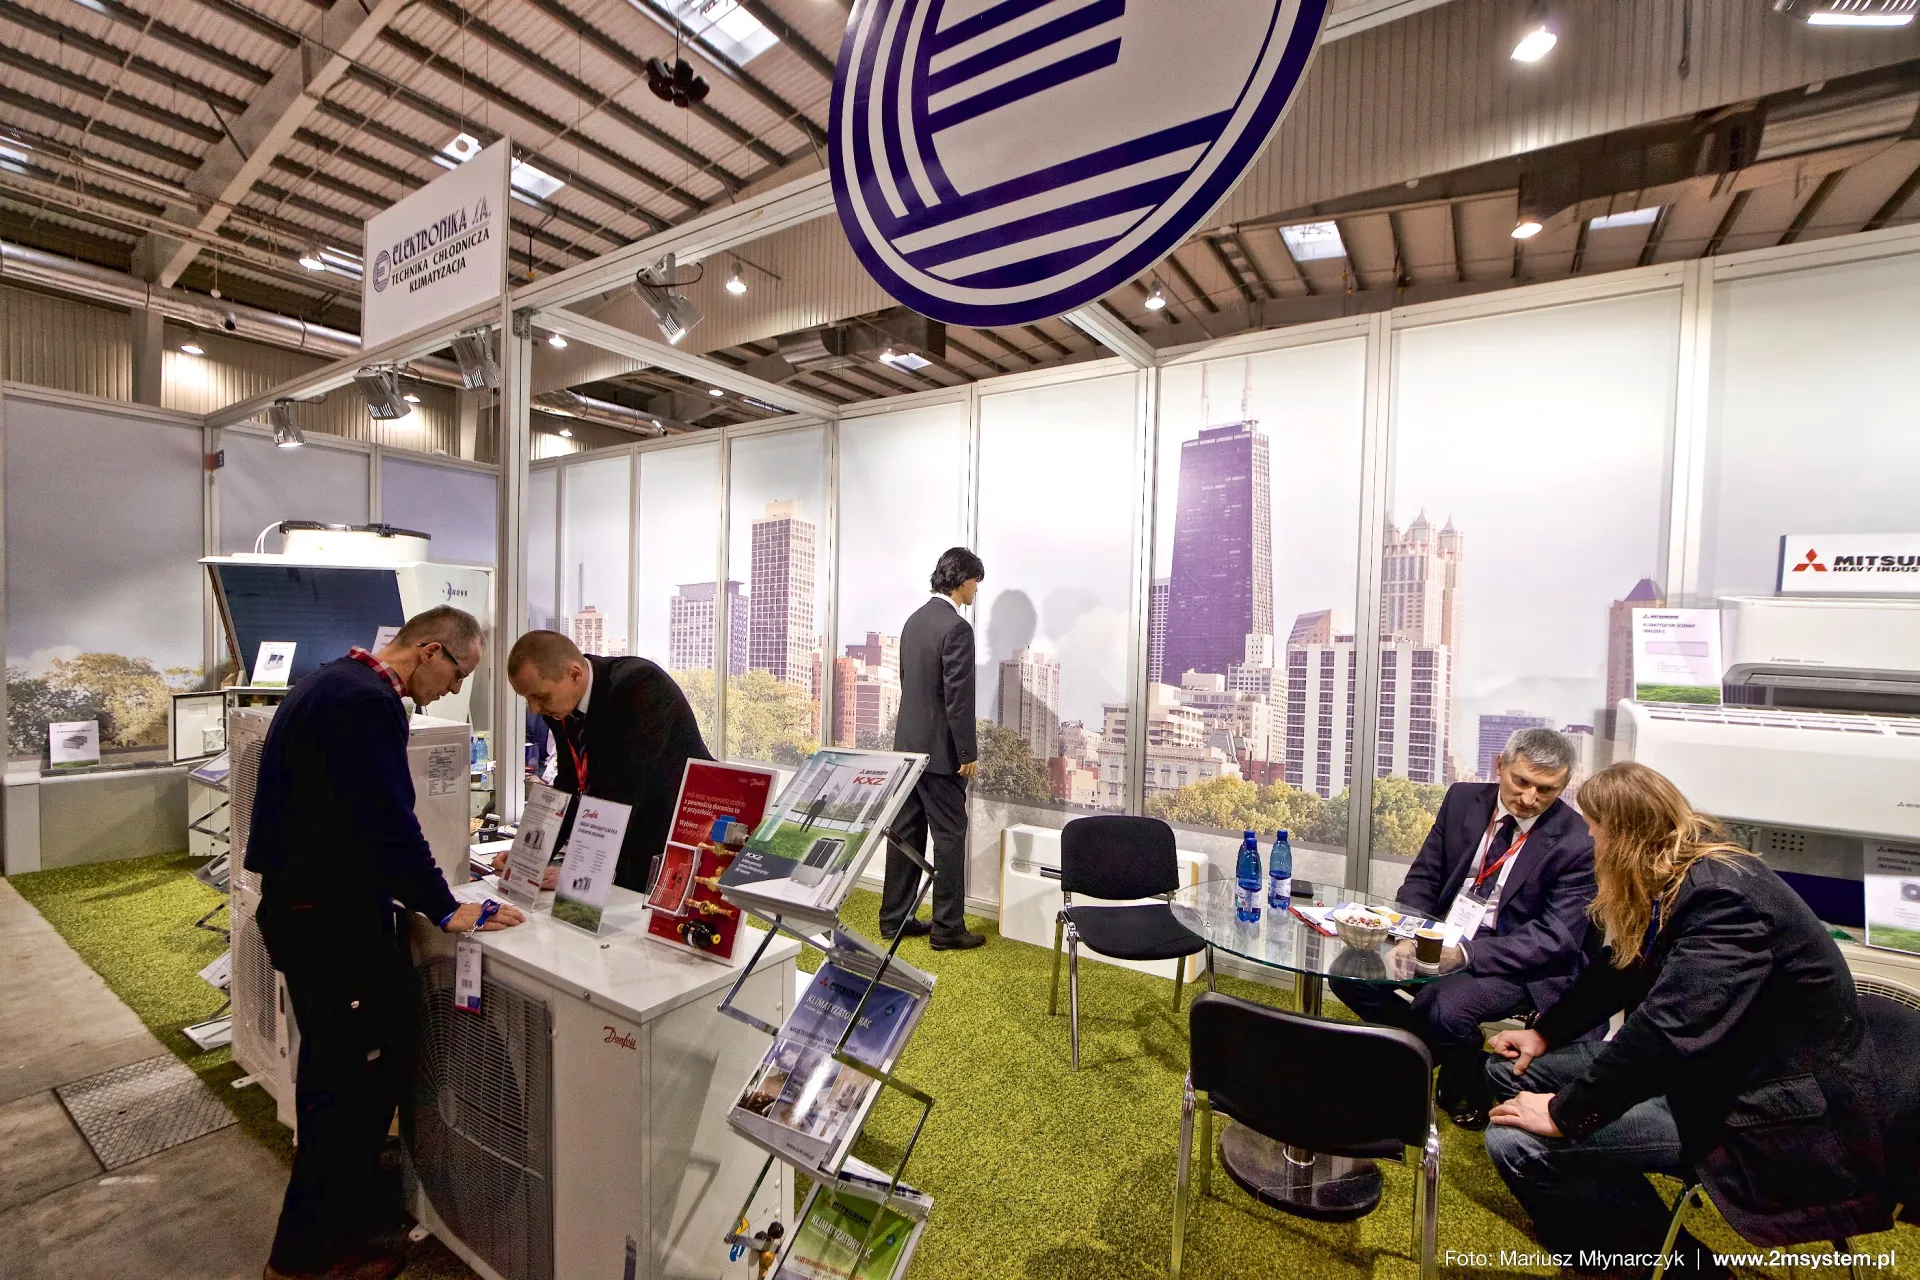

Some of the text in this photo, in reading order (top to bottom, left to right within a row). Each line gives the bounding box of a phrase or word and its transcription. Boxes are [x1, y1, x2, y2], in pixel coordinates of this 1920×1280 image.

[392, 207, 467, 266] ELEKTRONIKA
[391, 227, 490, 286] TECHNIKA CHŁODNICZA
[409, 257, 466, 293] KLIMATYZACJA
[853, 776, 886, 785] KXZ
[679, 819, 698, 829] Wybierz
[745, 852, 763, 860] KXZ
[603, 1026, 636, 1050] Danfoss
